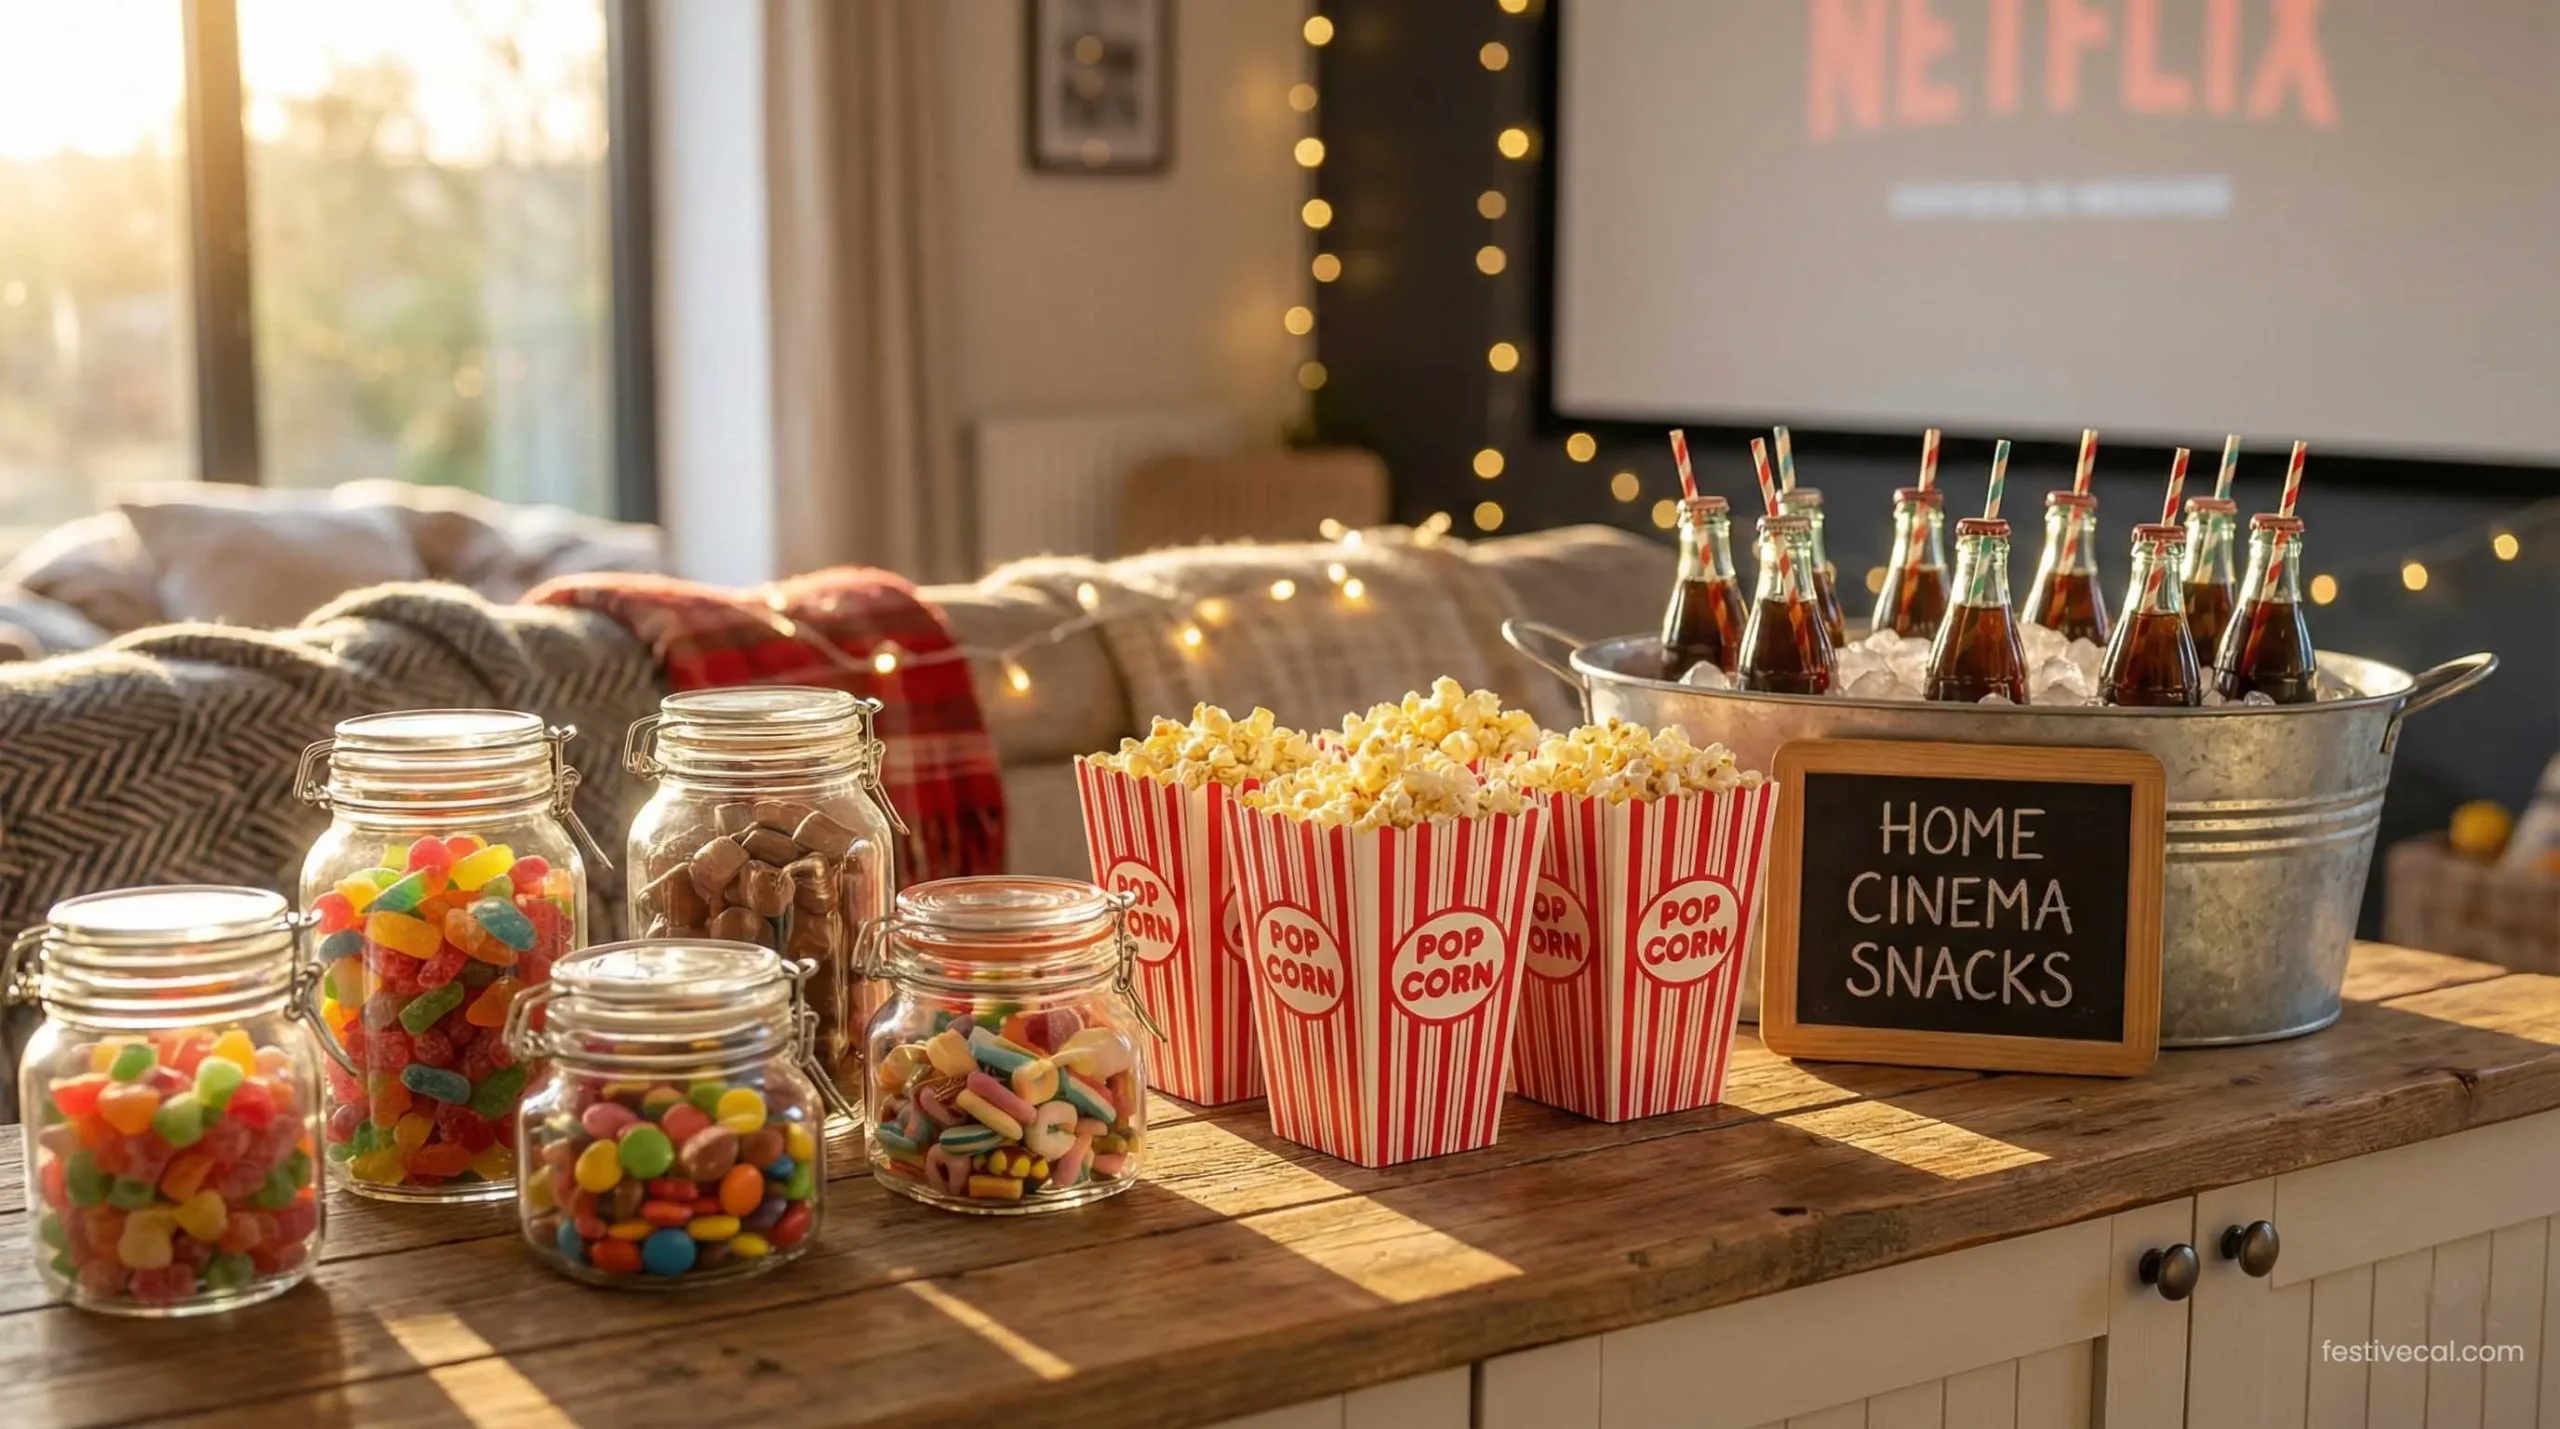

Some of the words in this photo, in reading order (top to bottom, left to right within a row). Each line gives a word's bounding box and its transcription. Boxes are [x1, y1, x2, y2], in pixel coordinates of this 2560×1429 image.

[1880, 801, 2046, 859] HOME
[1532, 892, 1566, 923] OP
[1660, 894, 1721, 930] POP
[1847, 871, 2073, 935] CINEMA
[1118, 910, 1174, 945] ORN
[1269, 919, 1320, 957] POP
[1416, 926, 1484, 964] POP
[1527, 925, 1582, 962] ORN
[1644, 926, 1728, 965] CORN
[1266, 953, 1336, 998] CORN
[1400, 959, 1494, 1001] CORN
[1846, 942, 2073, 1008] SNACKS
